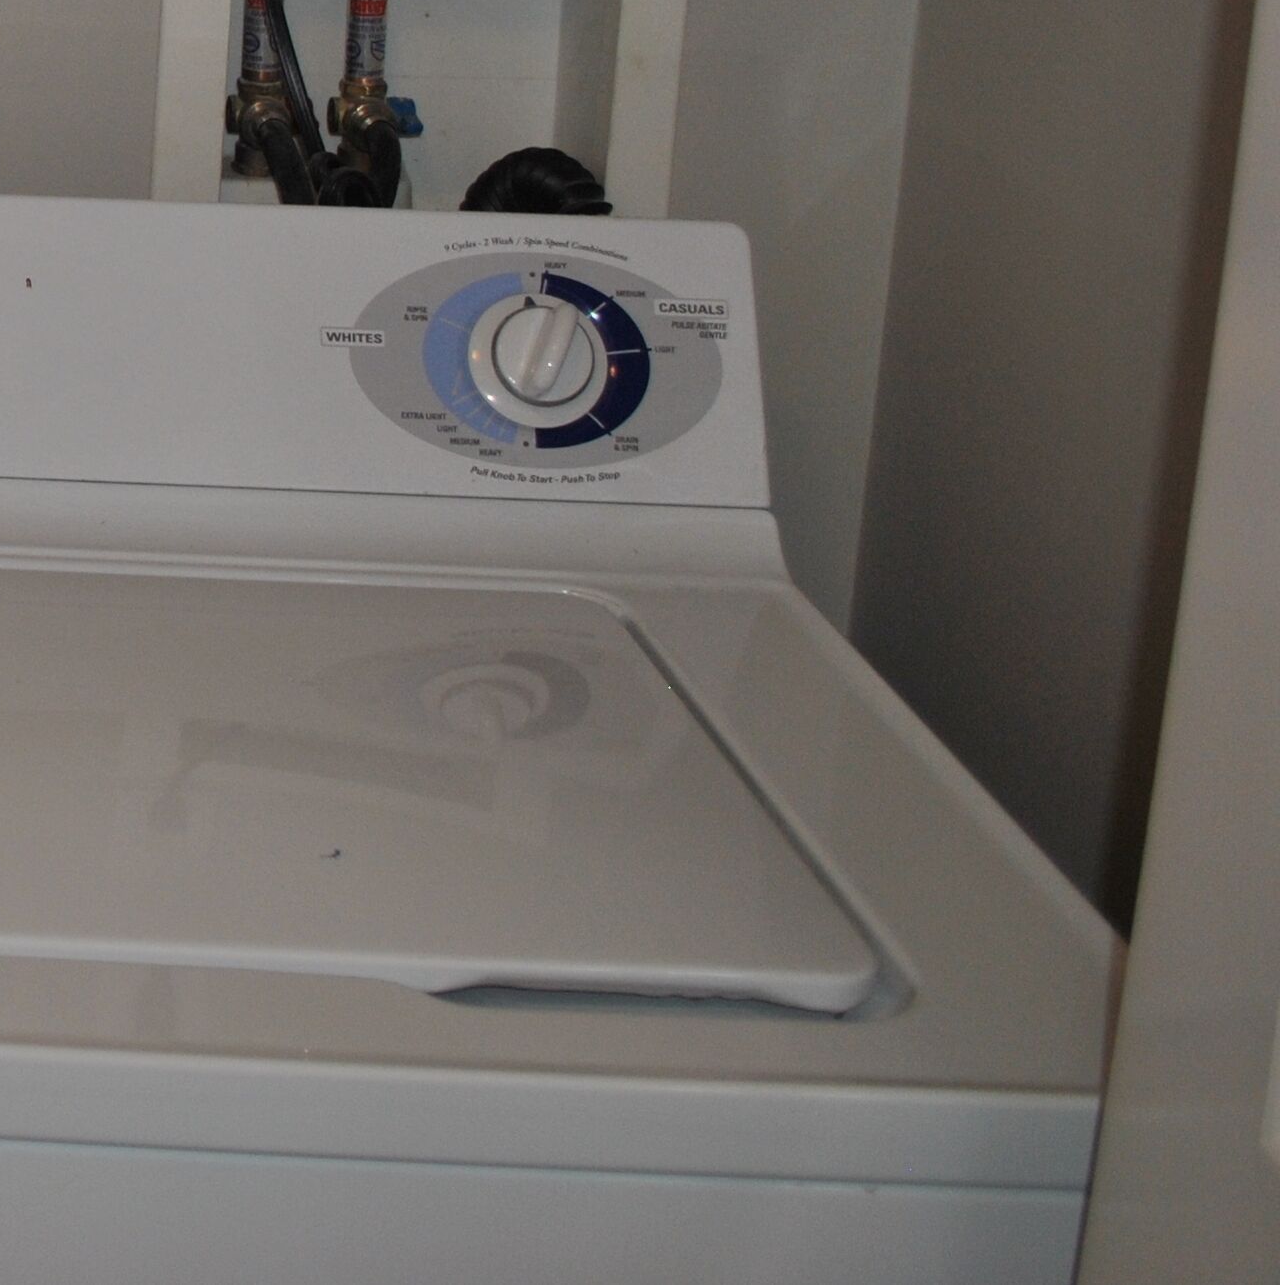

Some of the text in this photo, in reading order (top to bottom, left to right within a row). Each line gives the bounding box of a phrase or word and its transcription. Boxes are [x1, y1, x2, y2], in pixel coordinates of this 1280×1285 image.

[451, 241, 476, 252] Cycles
[483, 238, 489, 247] 2
[491, 237, 514, 246] Wash
[523, 237, 543, 247] Spin
[545, 238, 569, 249] Speed
[571, 241, 628, 261] Combinations
[659, 302, 725, 315] CASUALS
[671, 321, 695, 330] PULSE
[326, 332, 383, 344] WHITES
[699, 331, 728, 340] GENTLE
[401, 411, 447, 420] EXTRA LIGHT
[437, 425, 458, 433] LIGHT
[615, 436, 639, 444] DRAIN
[470, 466, 488, 477] Pull
[490, 470, 515, 482] Knob
[517, 473, 527, 483] To
[529, 475, 553, 484] Start
[561, 474, 584, 484] Push
[585, 474, 595, 483] To
[598, 472, 621, 481] Stop
